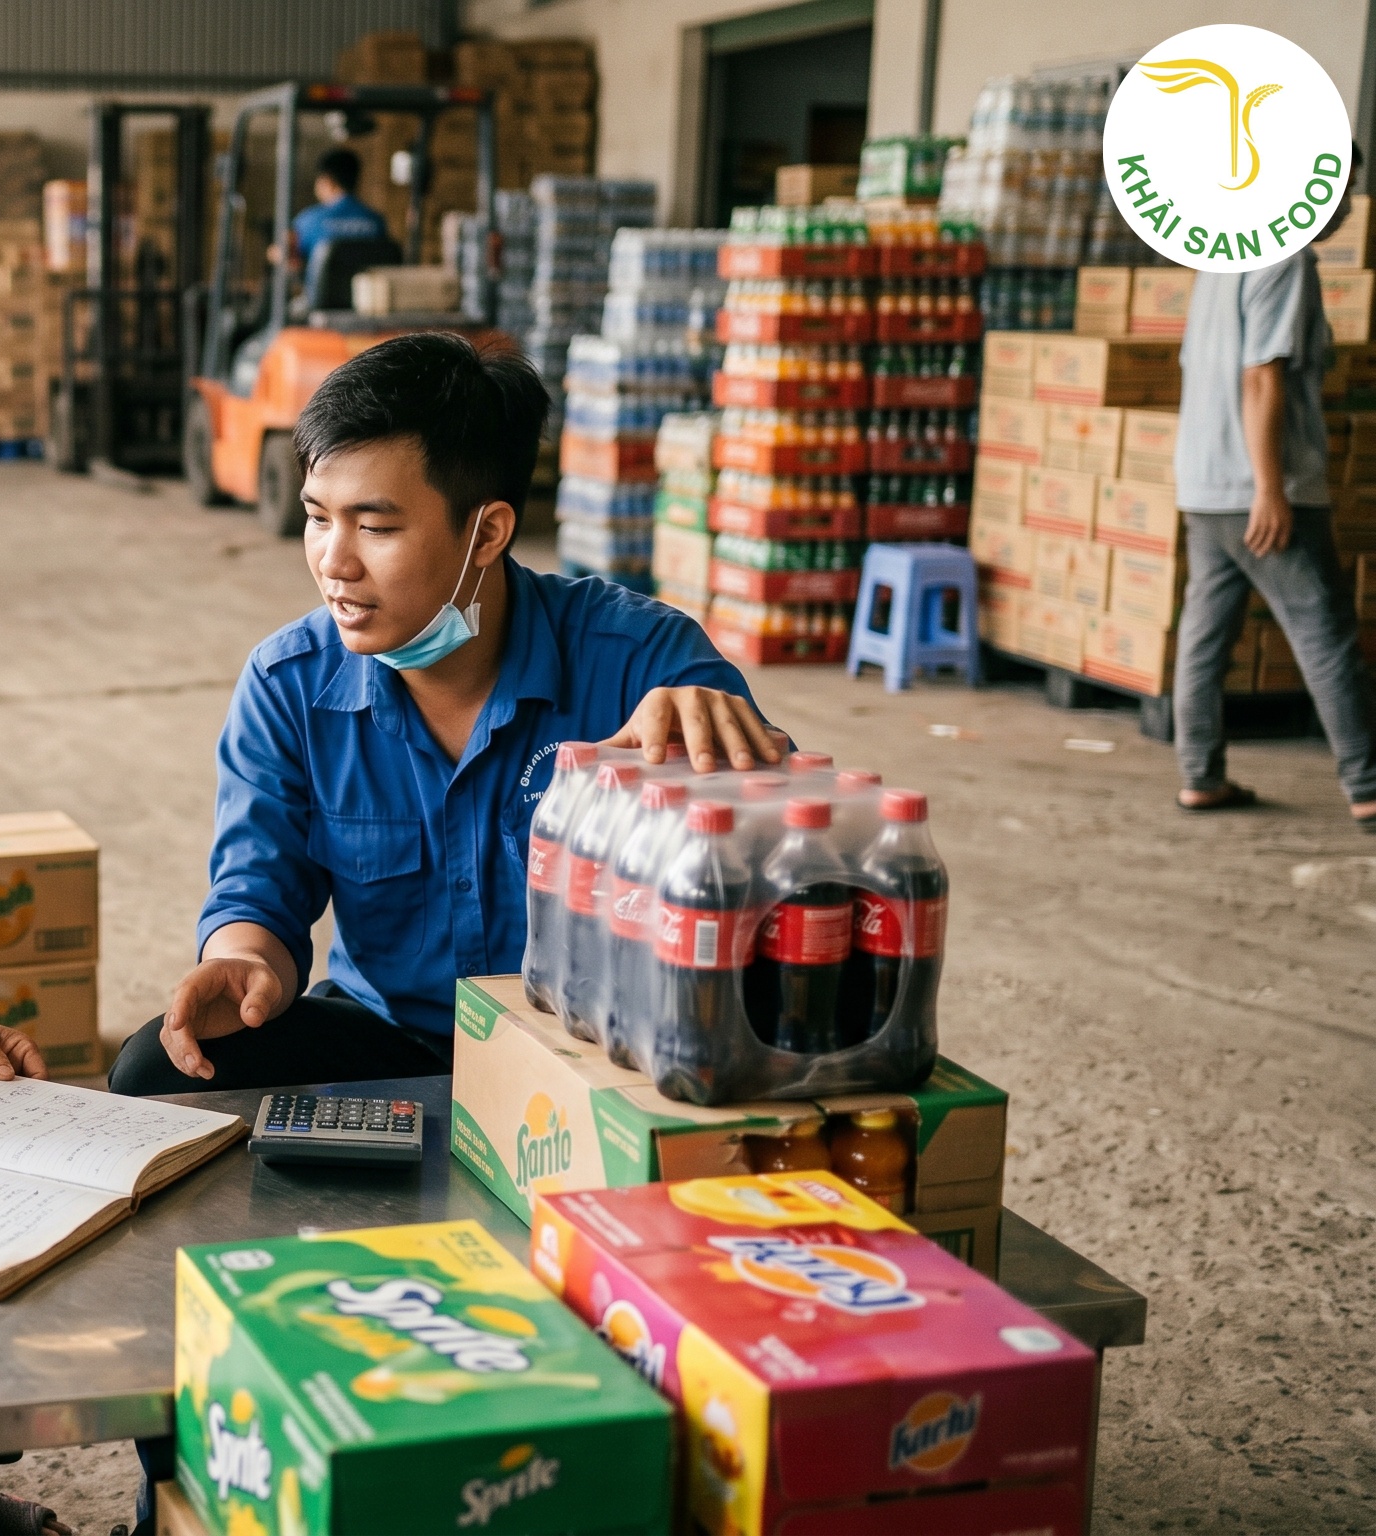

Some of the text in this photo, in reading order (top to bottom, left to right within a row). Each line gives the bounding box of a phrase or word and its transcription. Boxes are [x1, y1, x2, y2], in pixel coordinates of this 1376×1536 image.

[327, 1279, 531, 1373] Sprite
[208, 1402, 272, 1500] Sprite
[457, 1456, 560, 1527] Sprite
